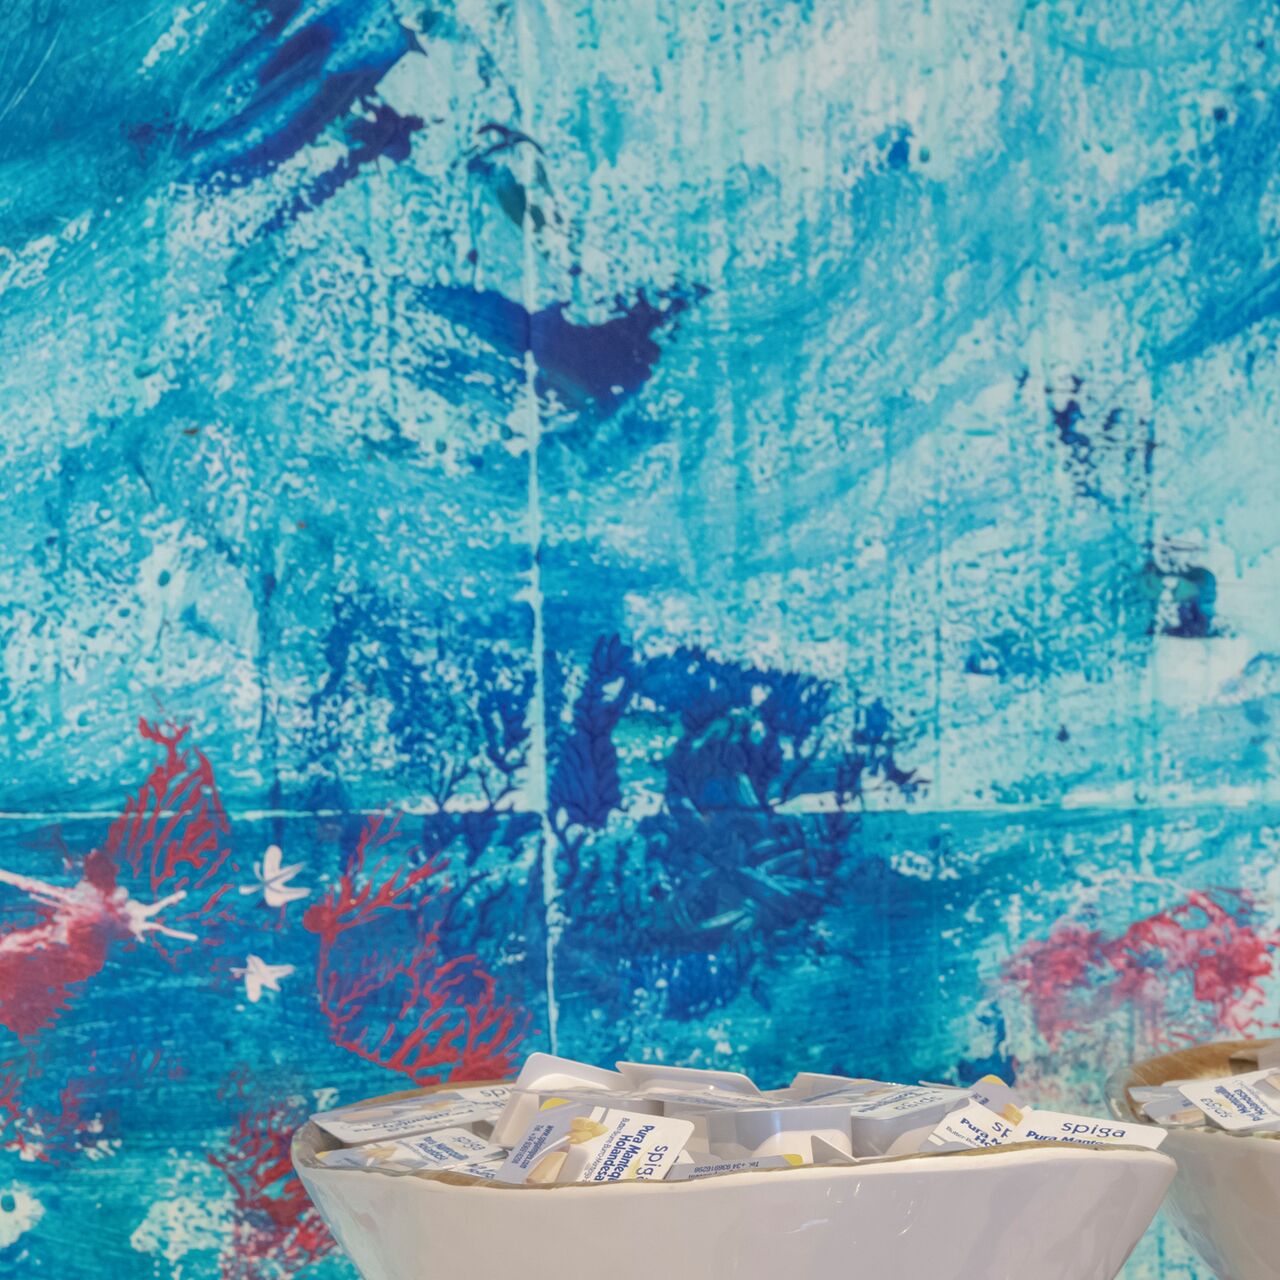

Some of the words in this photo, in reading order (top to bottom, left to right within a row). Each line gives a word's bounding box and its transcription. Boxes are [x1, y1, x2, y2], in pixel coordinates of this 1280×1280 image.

[633, 1125, 656, 1145] Pura
[960, 1117, 989, 1139] Pura
[1061, 1120, 1127, 1139] spiga
[594, 1134, 634, 1182] Holandesa
